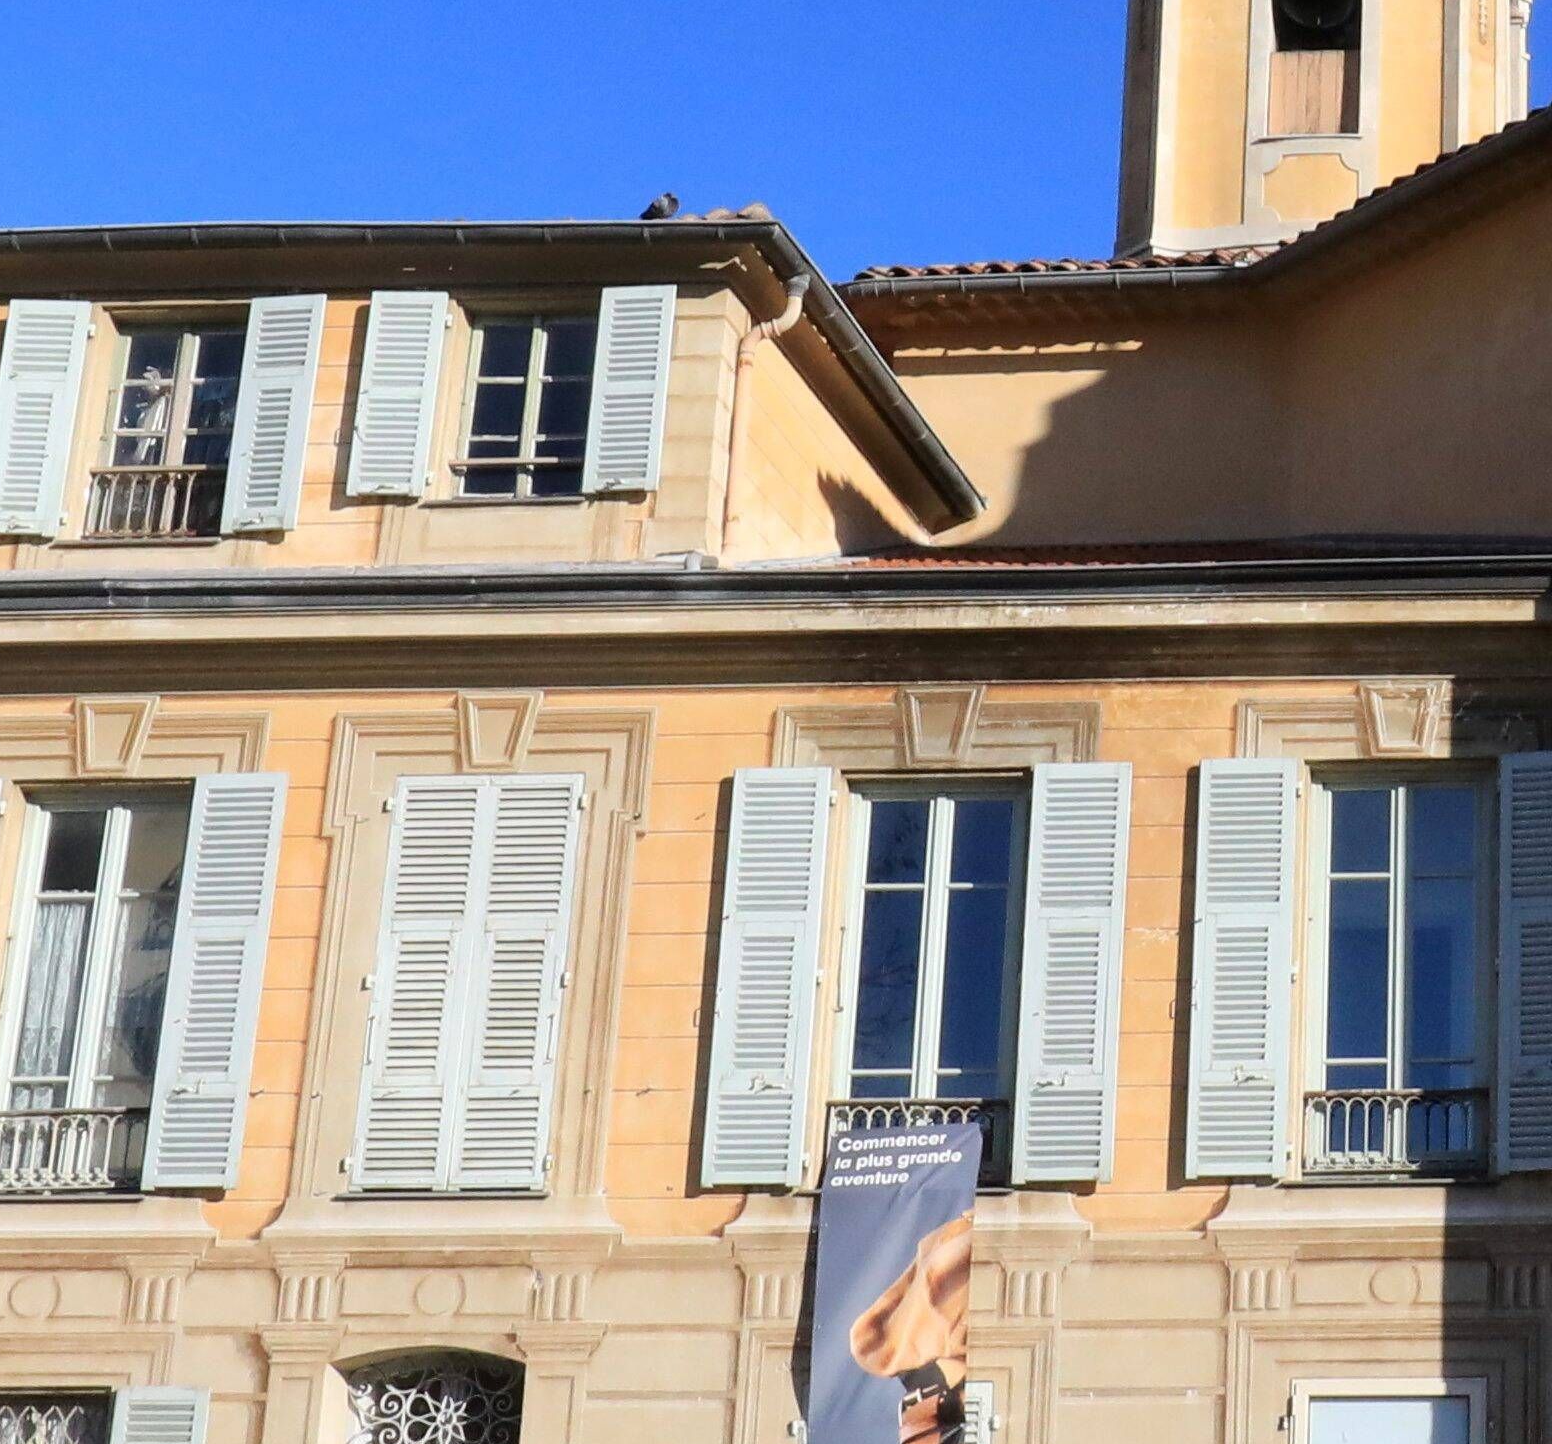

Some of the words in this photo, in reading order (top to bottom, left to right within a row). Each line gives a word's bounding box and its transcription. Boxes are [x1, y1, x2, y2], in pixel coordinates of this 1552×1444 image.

[838, 1133, 947, 1152] Commencer
[834, 1157, 851, 1170] la
[855, 1154, 893, 1171] plus
[898, 1149, 963, 1169] grande
[831, 1171, 910, 1187] aventure
